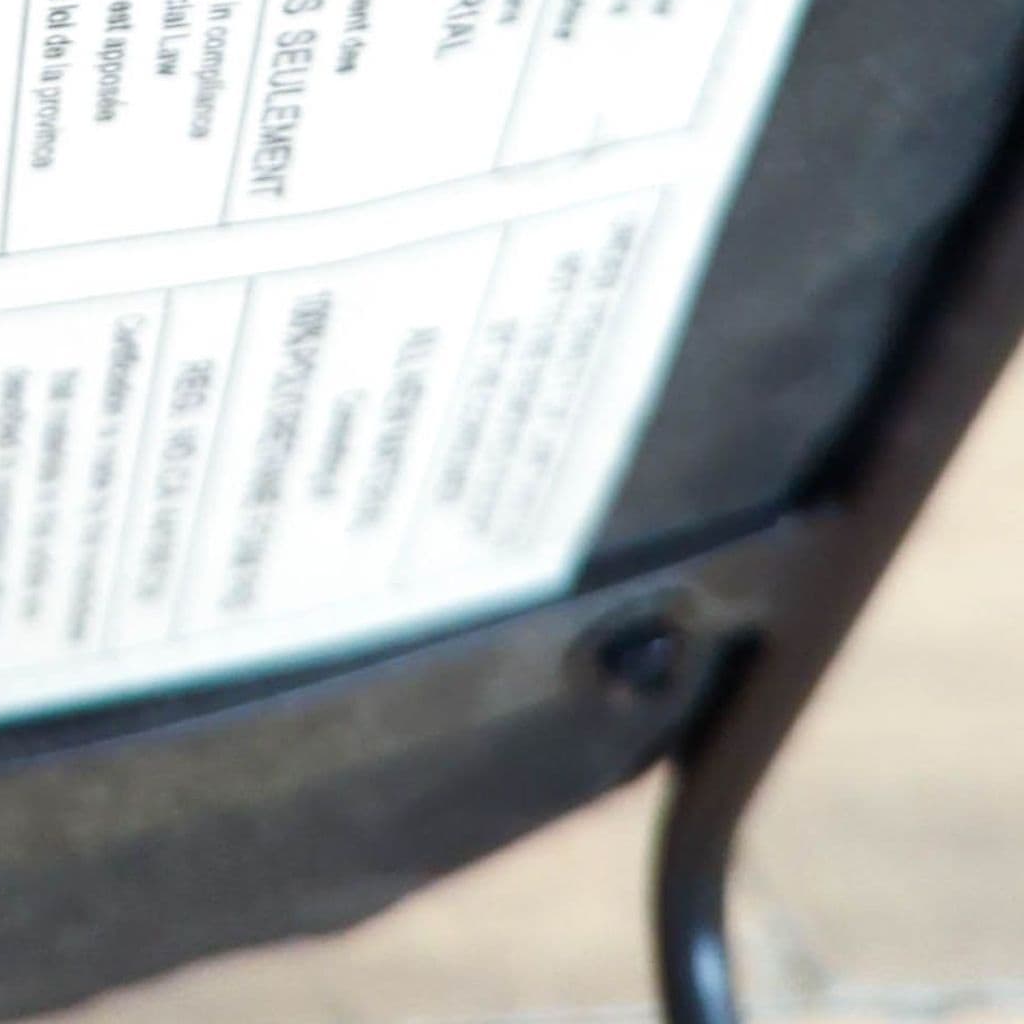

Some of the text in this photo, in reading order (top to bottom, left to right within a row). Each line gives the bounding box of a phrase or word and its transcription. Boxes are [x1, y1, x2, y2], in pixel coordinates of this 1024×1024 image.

[104, 1, 136, 32] est
[209, 2, 241, 21] in
[153, 33, 190, 76] Law
[188, 26, 233, 140] compliance
[247, 28, 322, 201] SEULEMENT
